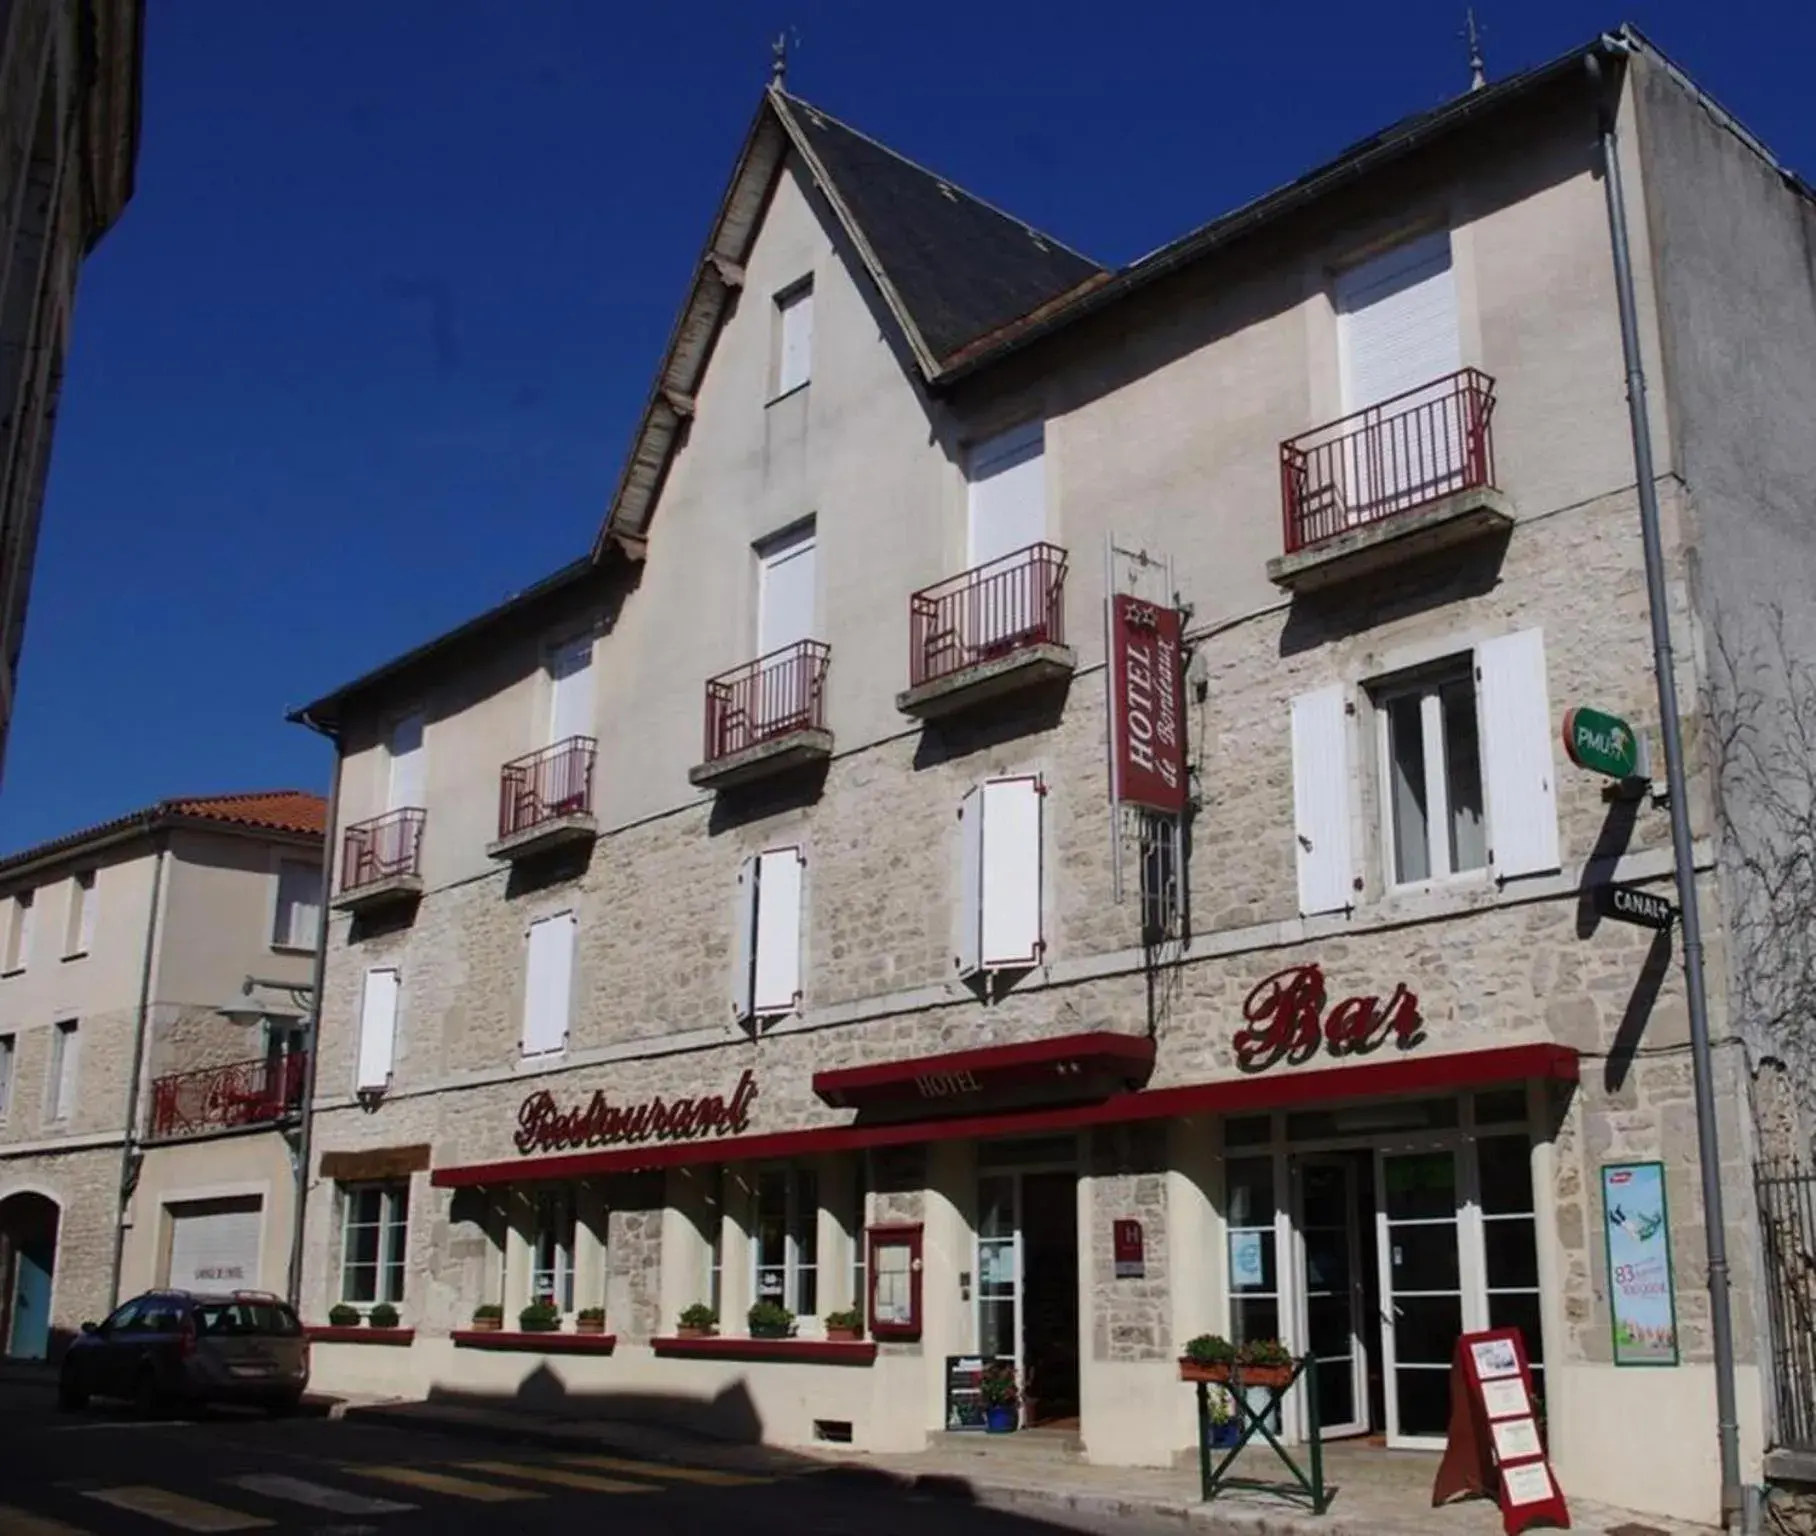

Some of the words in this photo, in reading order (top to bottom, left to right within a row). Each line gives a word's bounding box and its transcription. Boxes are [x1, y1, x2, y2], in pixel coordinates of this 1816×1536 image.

[1153, 636, 1176, 748] Bordeaux
[1127, 643, 1153, 773] HOTEL
[1577, 727, 1611, 755] PMU
[1155, 758, 1177, 788] de
[1614, 890, 1668, 920] CANAL+
[1234, 964, 1422, 1066] Bar
[915, 1070, 984, 1098] HOTEL
[515, 1069, 758, 1151] Restaurant
[1125, 1226, 1139, 1243] H
